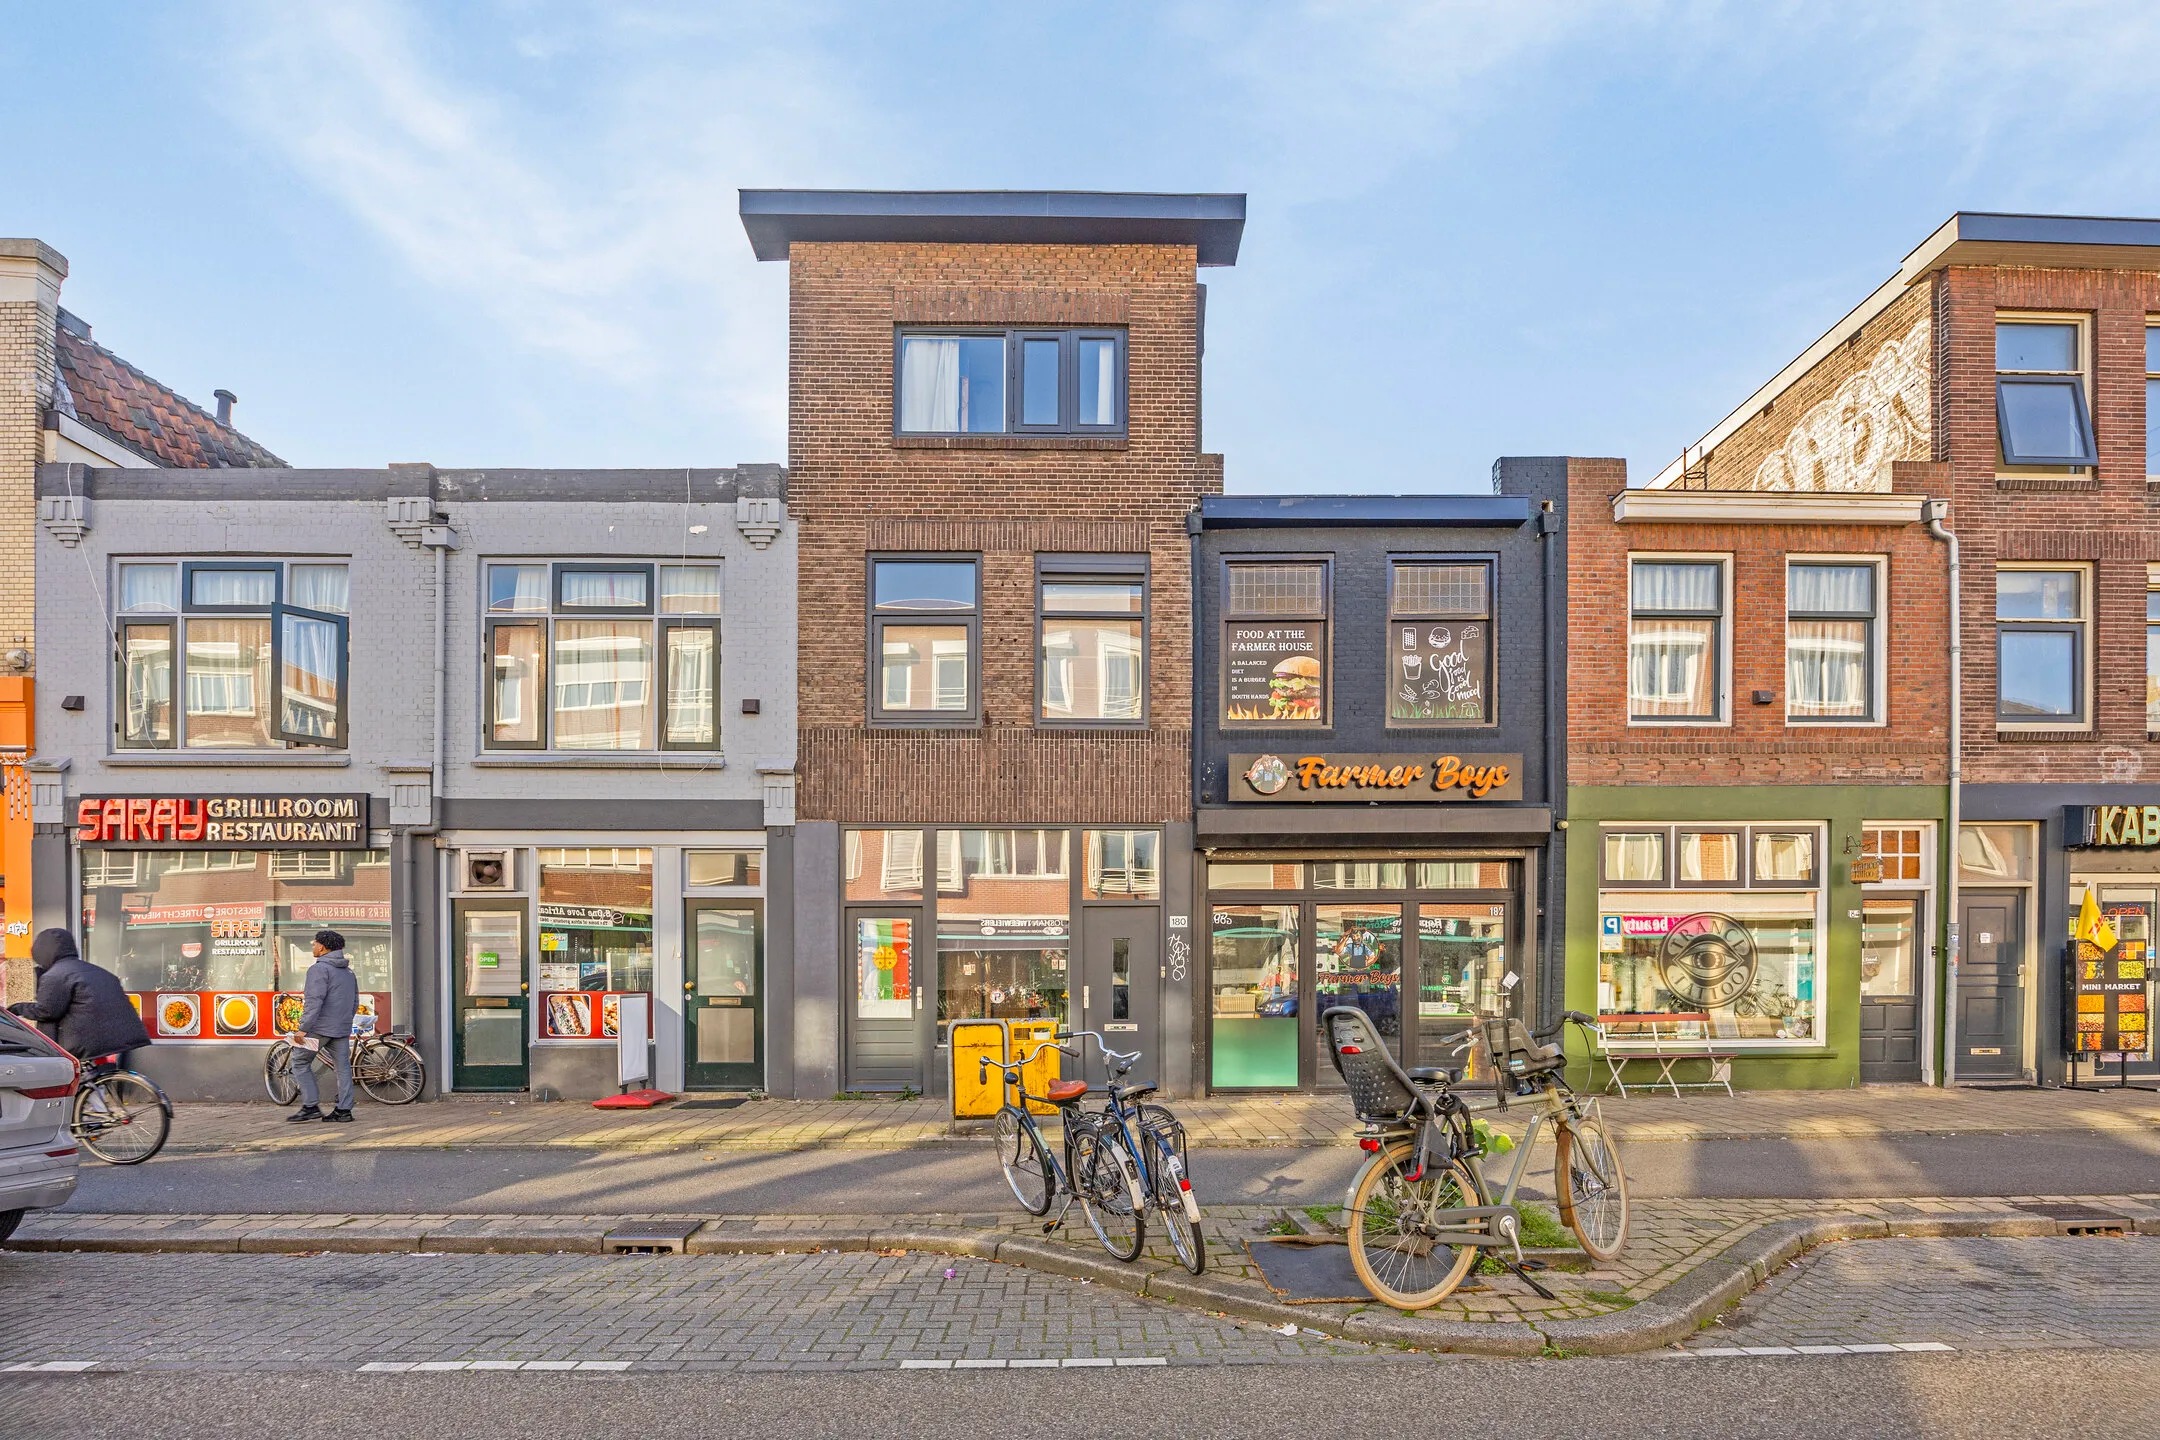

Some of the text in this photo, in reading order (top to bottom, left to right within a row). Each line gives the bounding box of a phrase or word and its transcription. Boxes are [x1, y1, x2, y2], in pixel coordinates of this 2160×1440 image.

[1236, 630, 1306, 639] FOOD AT THE
[1231, 642, 1314, 652] FARMER HOUSE
[1297, 755, 1511, 797] Farmer Boys
[206, 798, 358, 818] GRILLROOM
[78, 799, 206, 841] SARAY
[2101, 805, 2160, 845] KAB
[206, 822, 358, 842] RESTAURANT
[1489, 906, 1504, 916] 182
[2108, 906, 2145, 915] OPEN
[211, 919, 262, 938] SARAY
[1171, 917, 1187, 926] 180
[214, 939, 259, 947] GRILLROOM
[1670, 920, 1746, 949] TRANCE
[1317, 970, 1400, 986] Farmer Boys
[1674, 971, 1745, 1000] TATTOO
[2081, 983, 2102, 991] MINI
